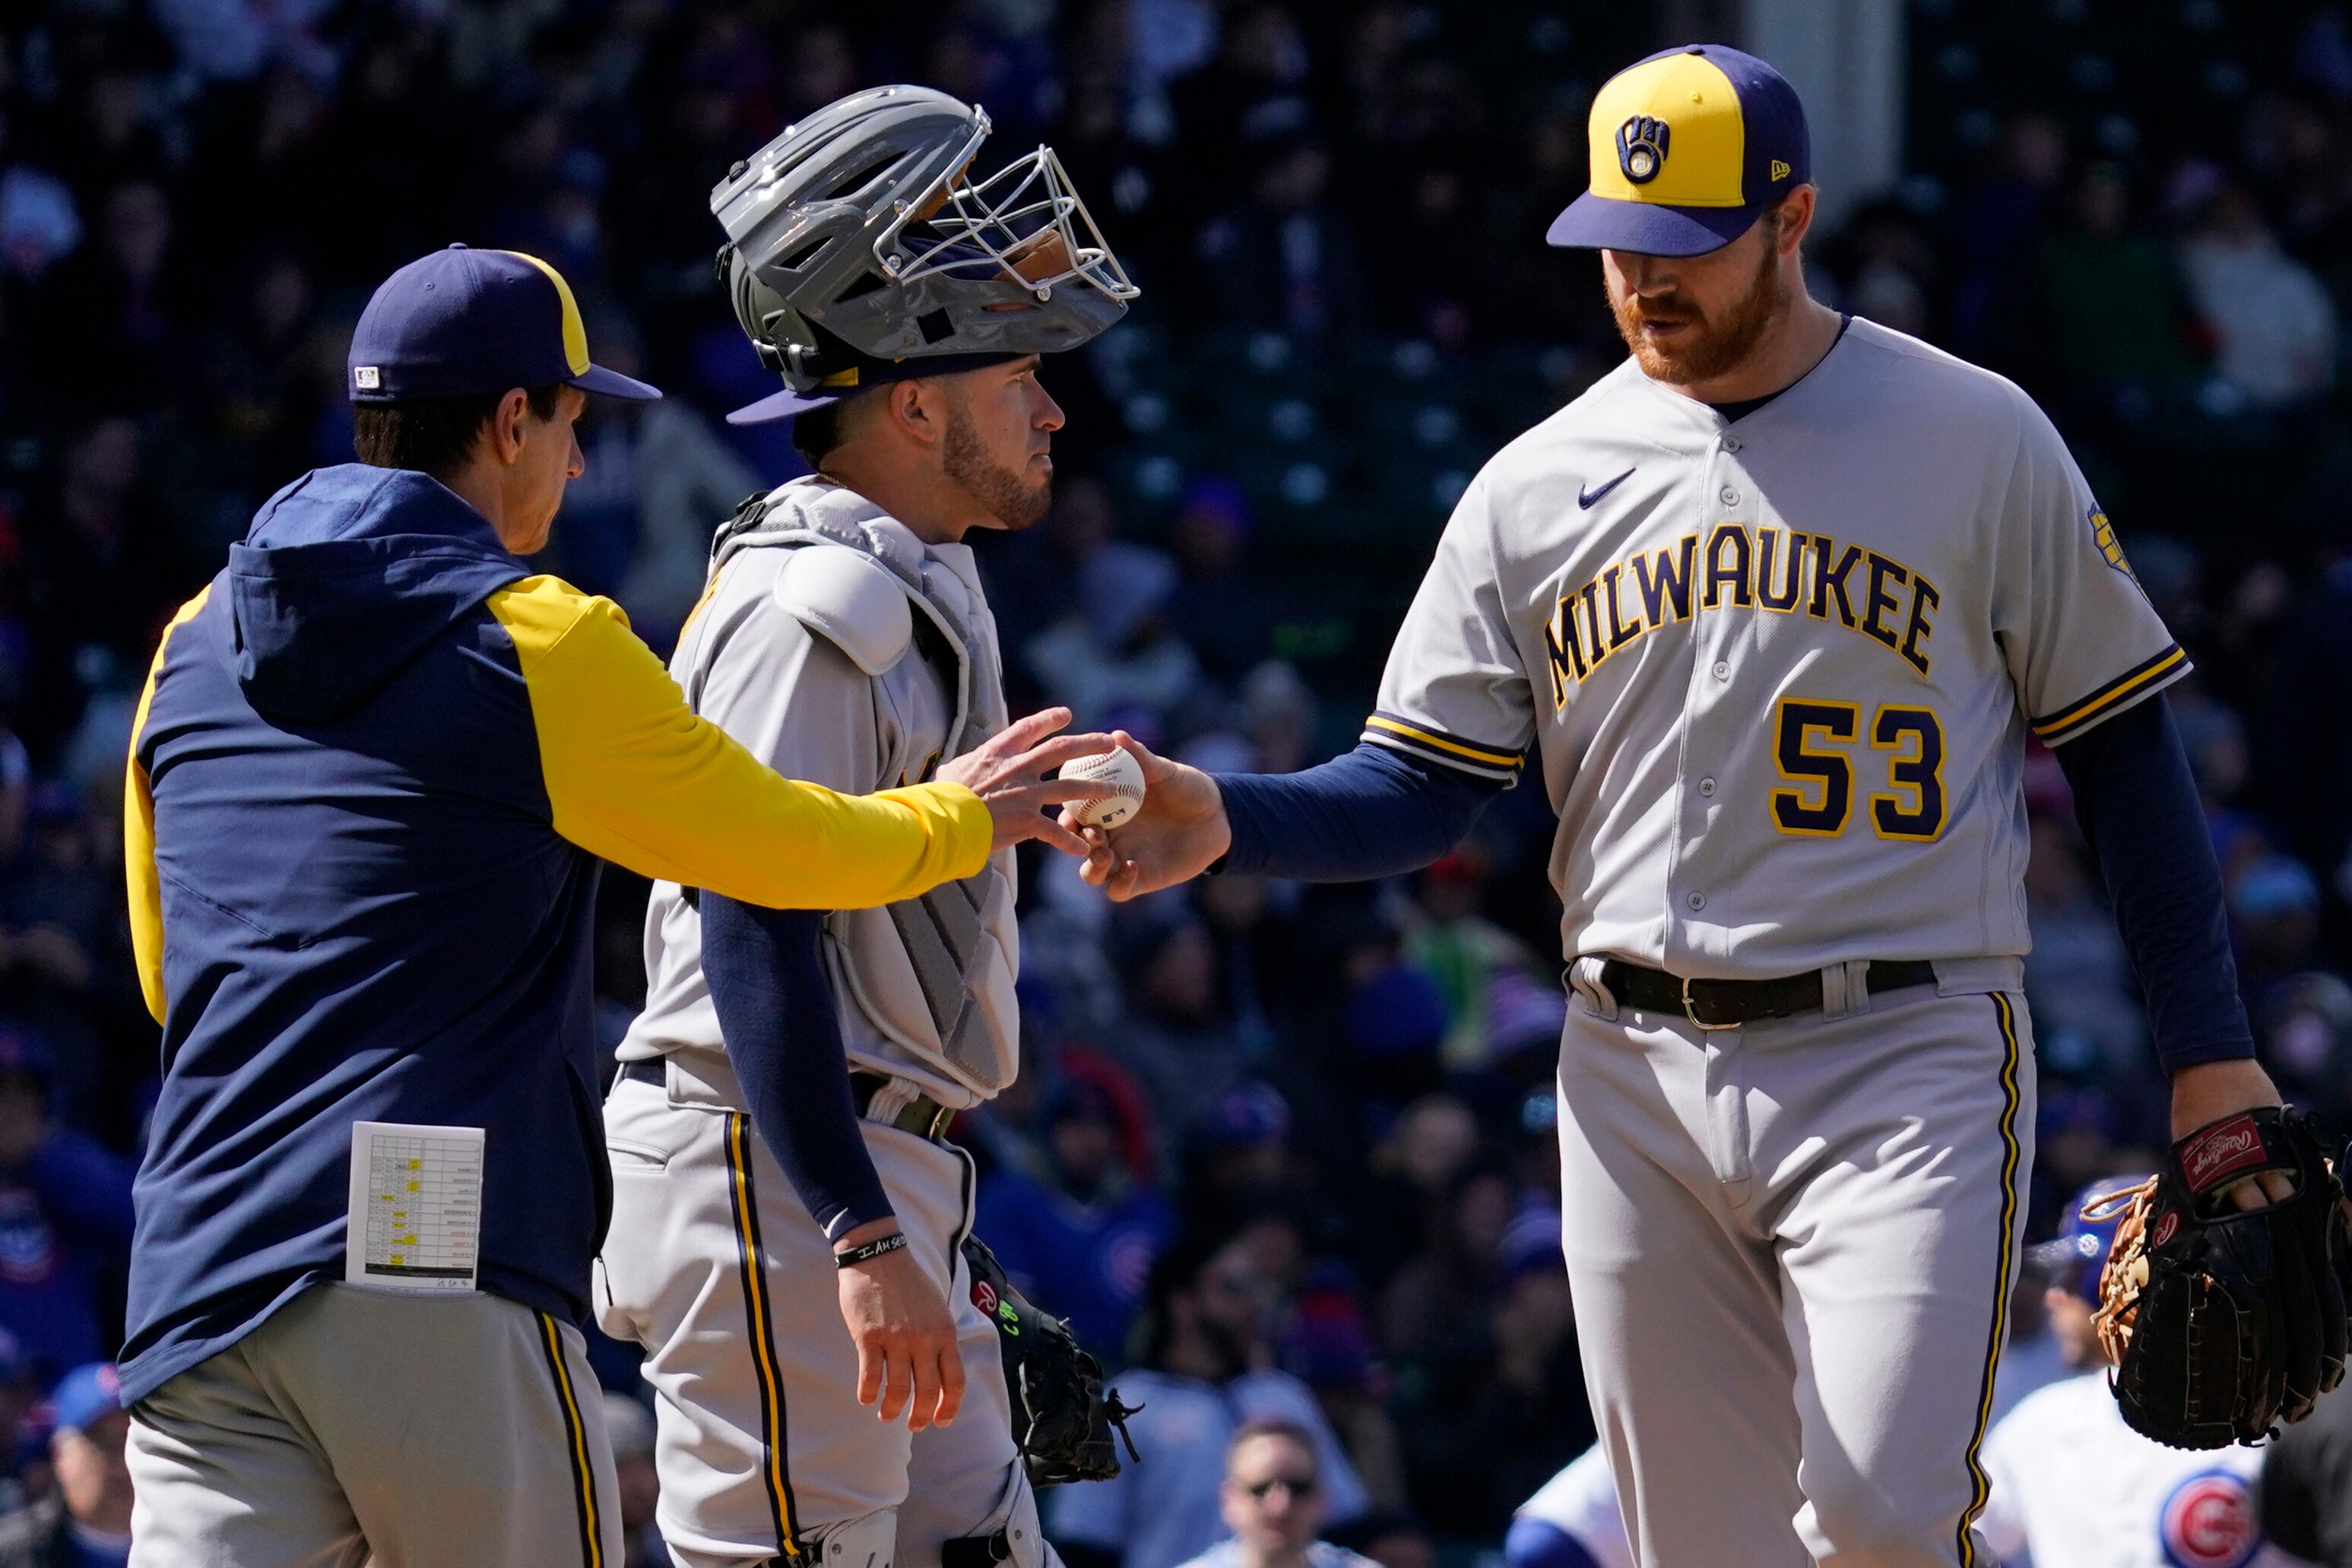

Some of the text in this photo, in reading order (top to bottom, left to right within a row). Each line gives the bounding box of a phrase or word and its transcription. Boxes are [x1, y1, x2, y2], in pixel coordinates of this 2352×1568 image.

[1542, 522, 1941, 713] MILWAUKEE
[1769, 696, 1948, 842] 53
[2193, 1131, 2252, 1175] Rawlings
[857, 1246, 874, 1259] I
[876, 1240, 890, 1255] AM
